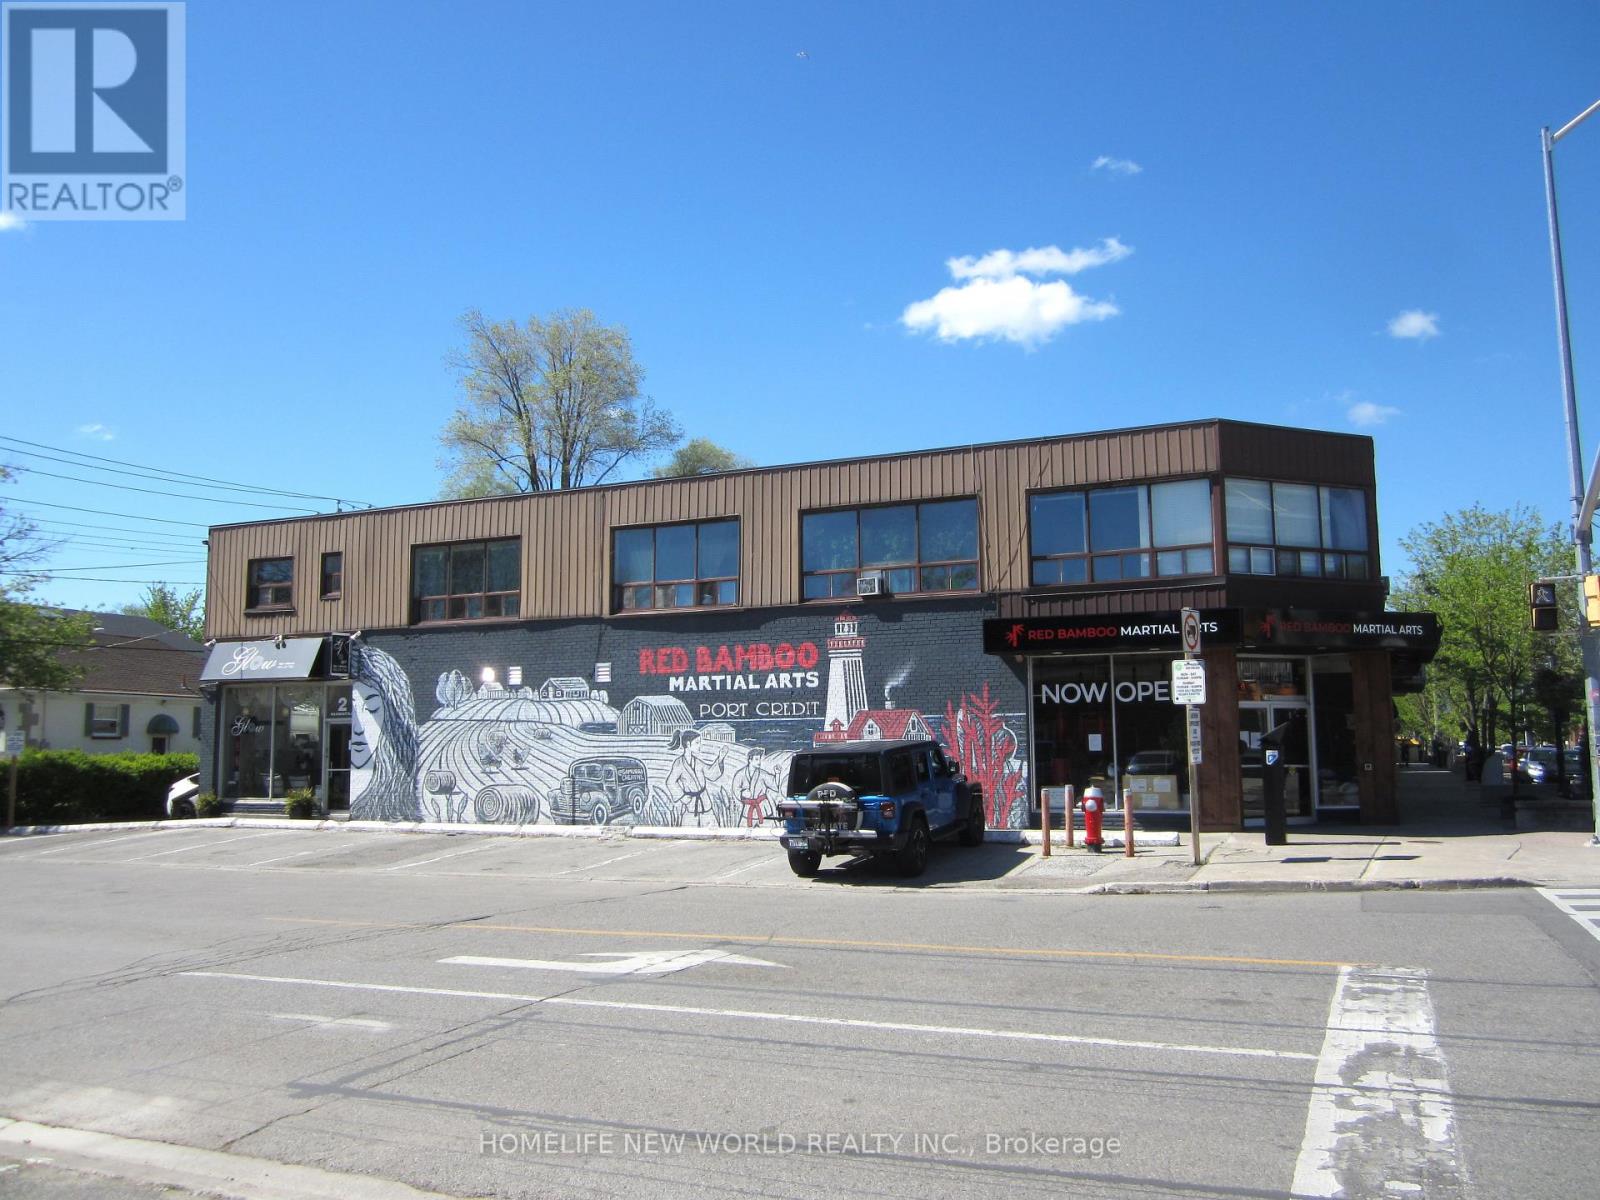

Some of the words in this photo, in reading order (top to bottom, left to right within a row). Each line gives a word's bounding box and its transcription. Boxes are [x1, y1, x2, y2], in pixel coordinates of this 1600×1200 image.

[1028, 629, 1054, 641] RED
[1058, 626, 1118, 640] BAMBOO
[1120, 623, 1180, 636] MARTIAL
[1353, 623, 1397, 635] MARTIAL
[1399, 625, 1423, 635] ARTS
[222, 646, 277, 676] Glow
[639, 646, 689, 674] RED
[695, 642, 820, 673] BAMBOO
[669, 673, 761, 692] MARTIAL
[764, 671, 819, 689] ARTS
[1041, 682, 1108, 704] NOW
[1115, 681, 1170, 702] OPE
[338, 697, 347, 712] 2
[700, 702, 748, 718] PORT
[756, 701, 820, 716] CREDIT
